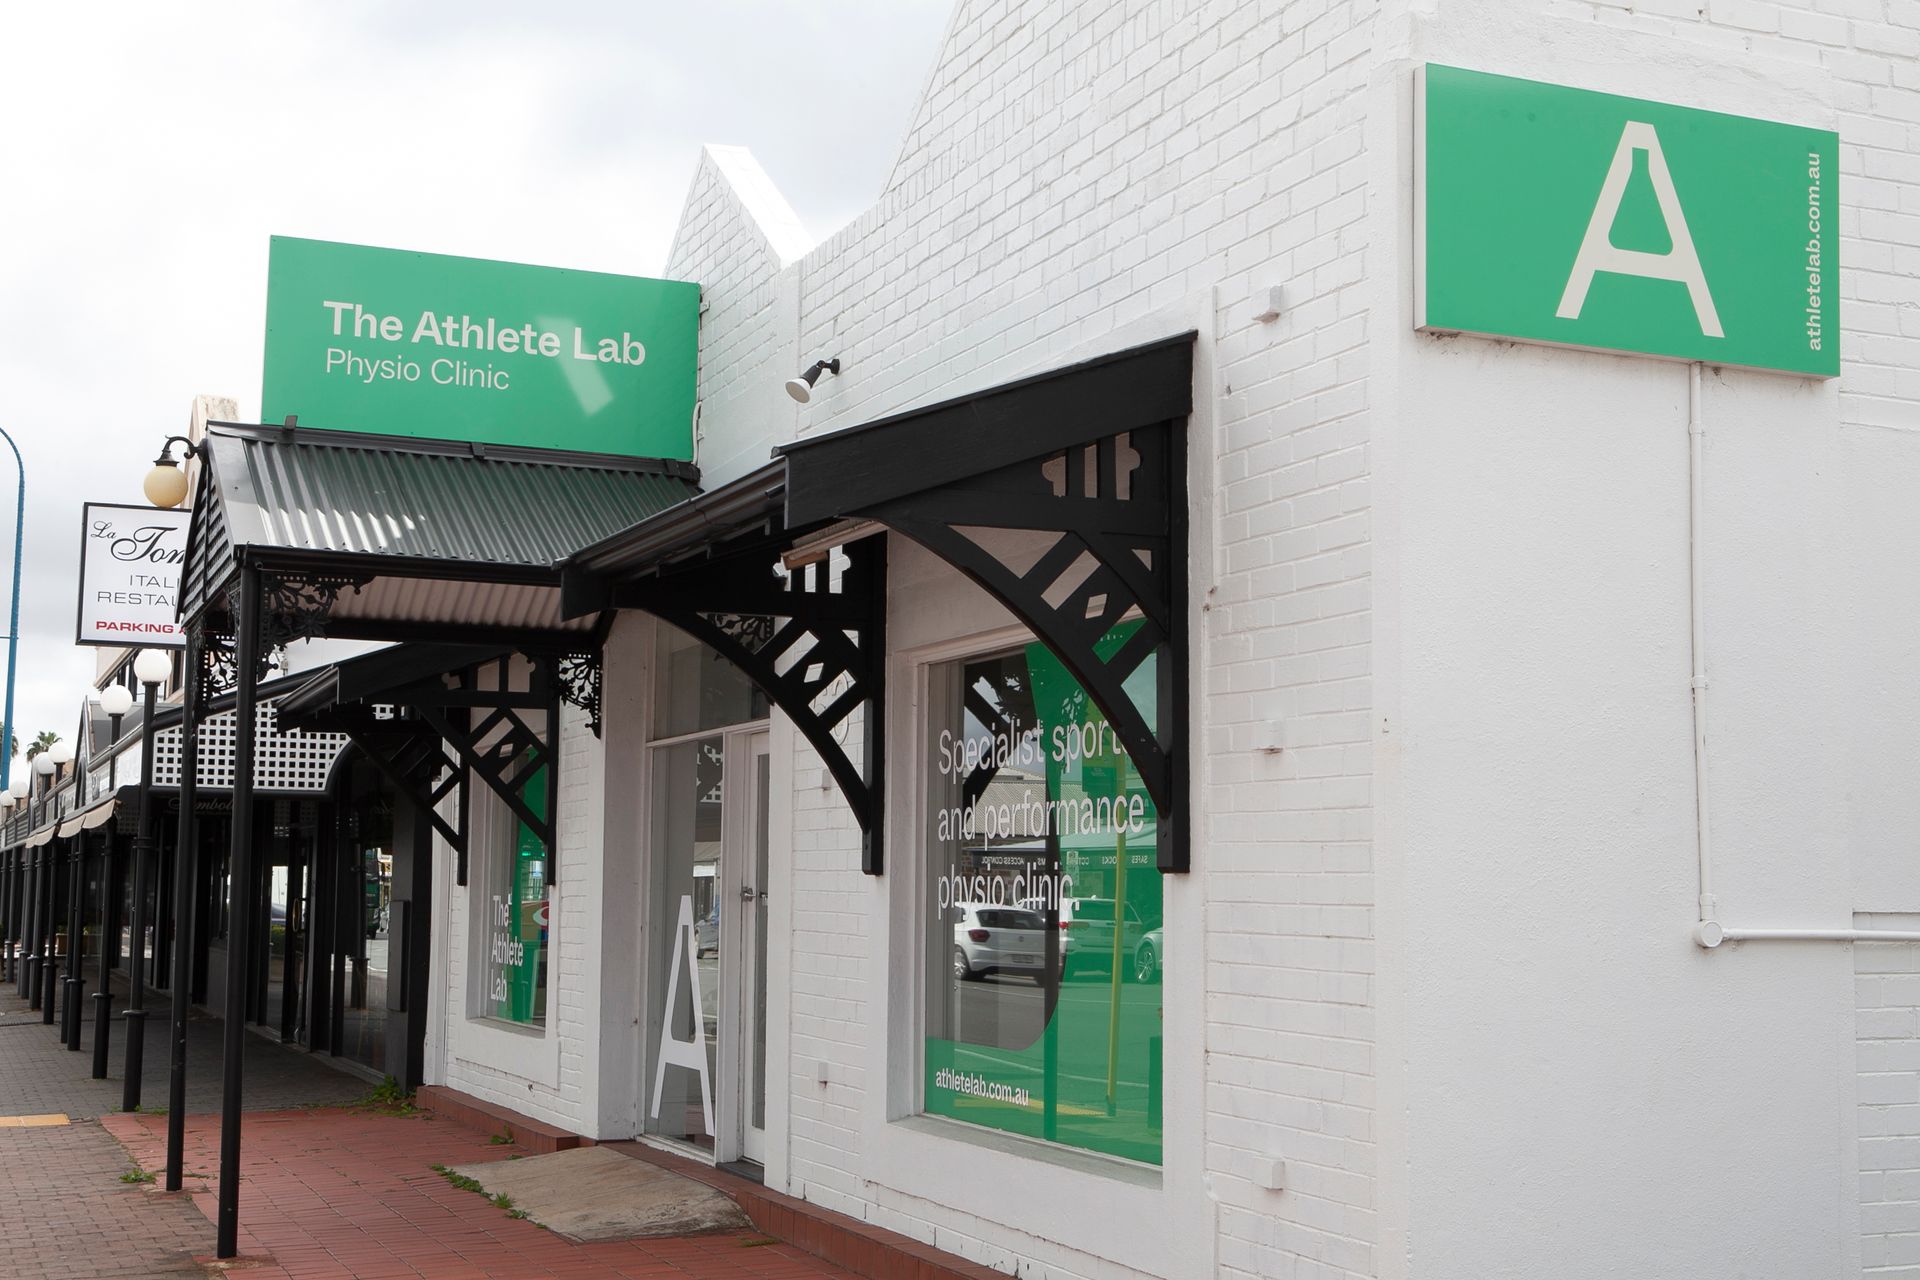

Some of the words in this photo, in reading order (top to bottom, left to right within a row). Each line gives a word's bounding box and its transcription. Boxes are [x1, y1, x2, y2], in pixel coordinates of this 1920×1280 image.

[1555, 120, 1725, 338] A
[1805, 153, 1821, 351] athletelab.com.au
[323, 300, 403, 341] The
[411, 311, 561, 357] Athlete
[573, 327, 646, 366] Lab
[326, 348, 421, 384] Physio
[431, 357, 509, 390] Clinic
[90, 520, 117, 539] La
[96, 621, 174, 634] PARKING
[938, 718, 1045, 784] Specialist
[1052, 720, 1128, 774] sport
[938, 794, 976, 842] and
[984, 790, 1145, 851] performance
[493, 895, 509, 928] The
[938, 862, 1005, 920] physio
[1012, 861, 1080, 911] clinic.
[491, 932, 524, 967] Athlete
[490, 968, 508, 1002] Lab
[650, 895, 715, 1137] A
[935, 1067, 1029, 1106] athletelab.com.au
